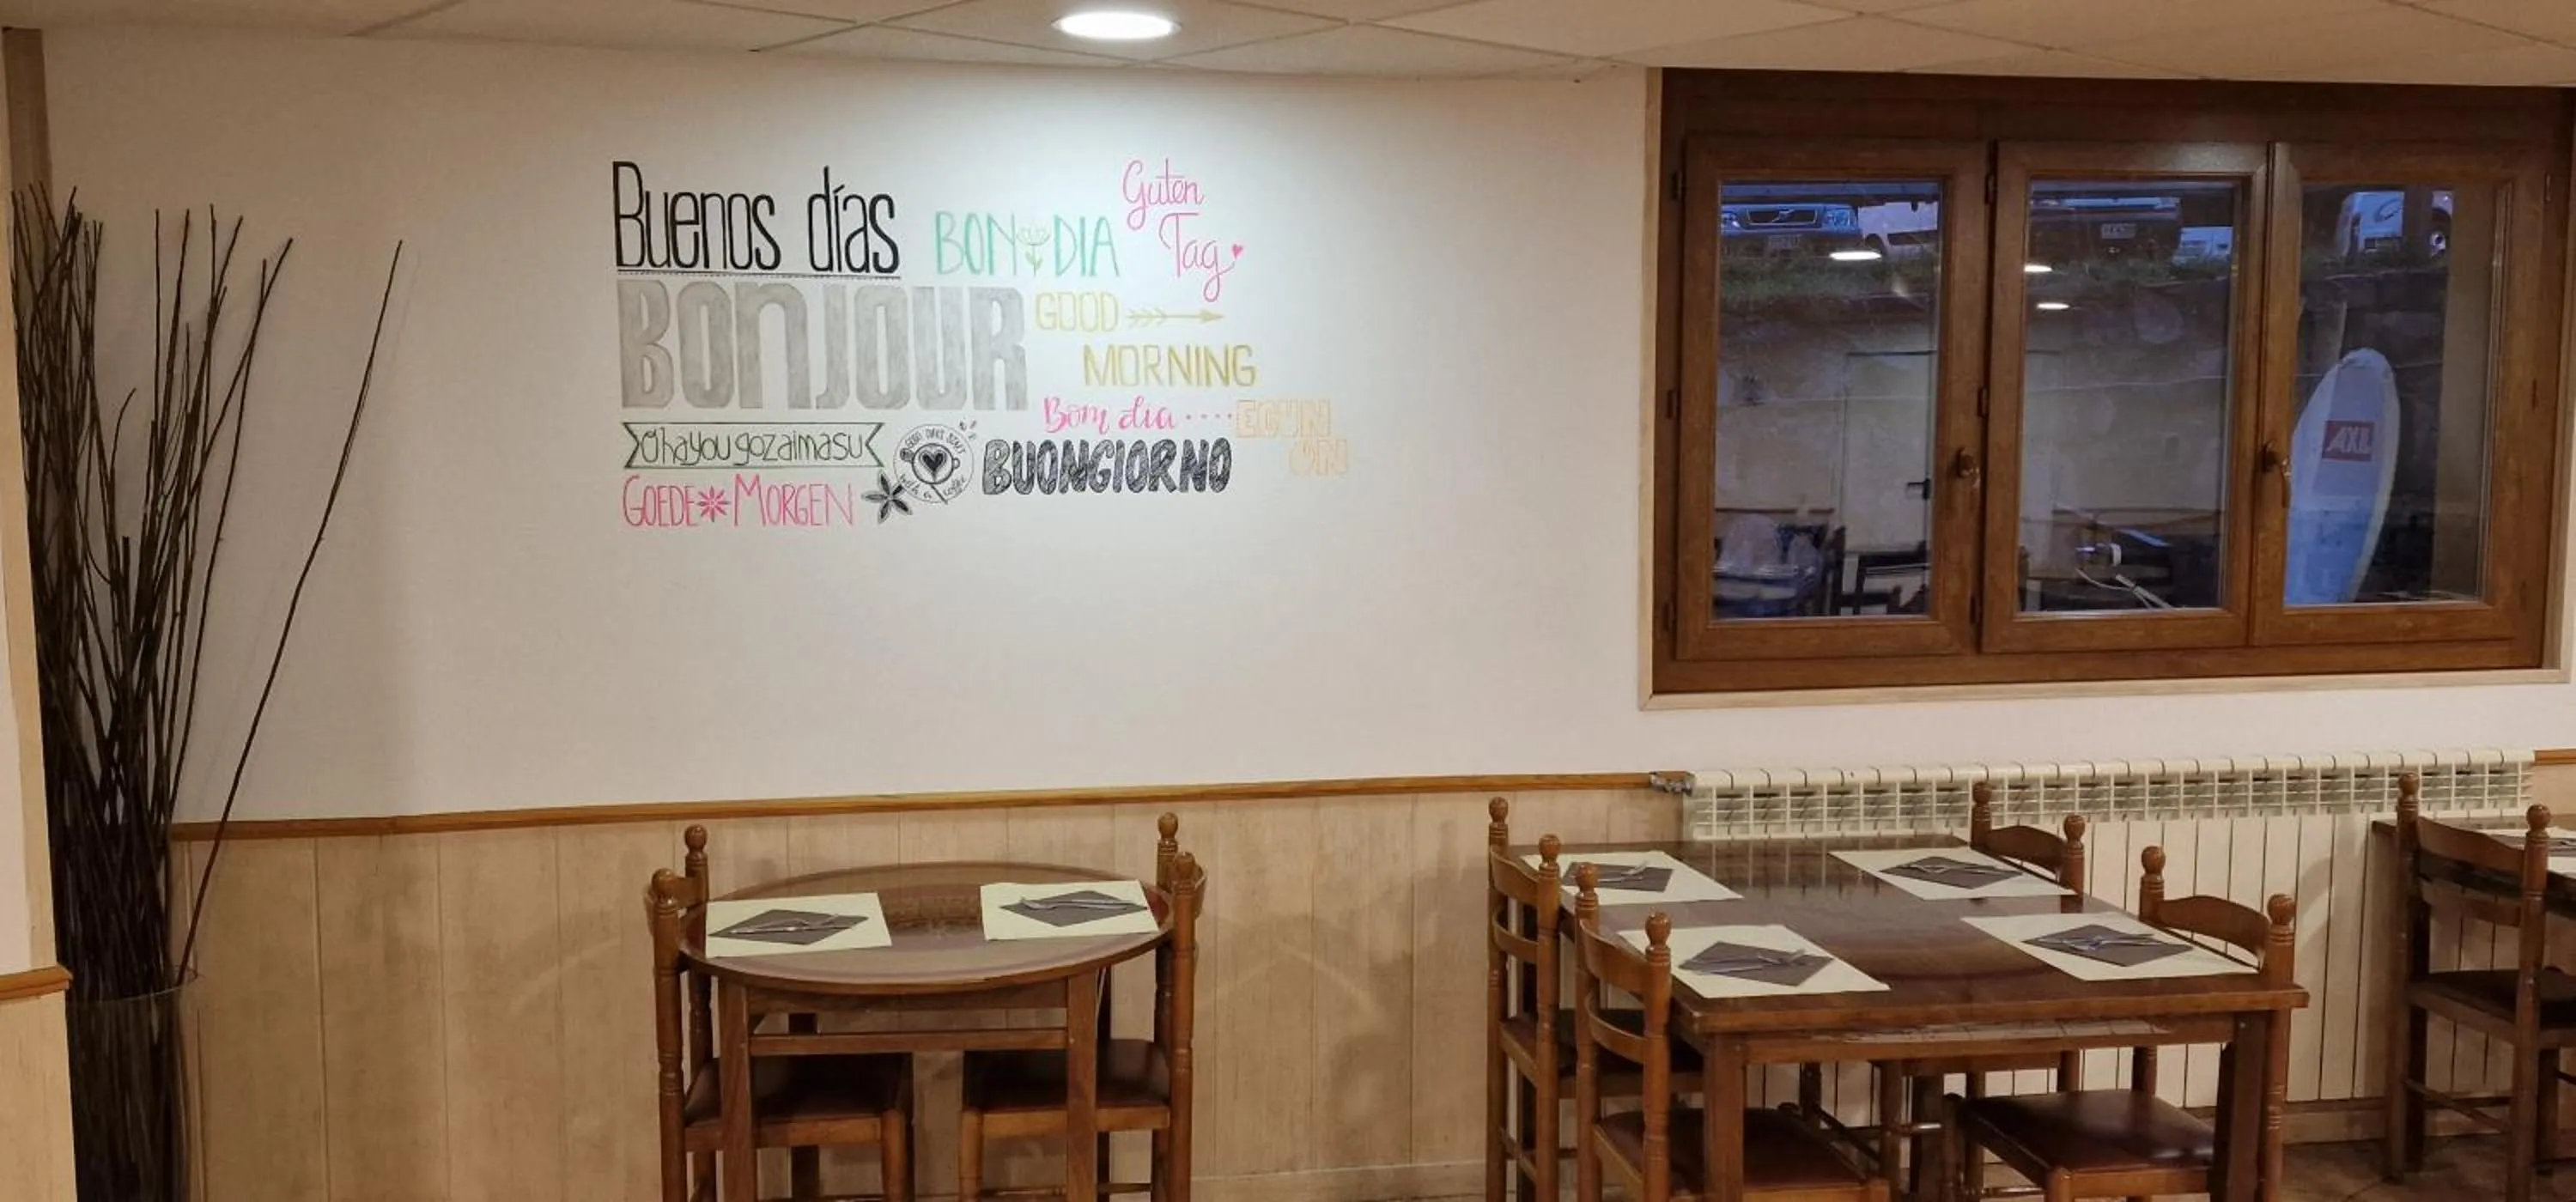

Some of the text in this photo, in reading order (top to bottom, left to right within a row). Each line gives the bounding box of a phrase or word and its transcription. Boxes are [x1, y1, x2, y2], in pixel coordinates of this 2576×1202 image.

[612, 161, 899, 273] Buenos días
[1122, 157, 1205, 231] Guten
[935, 210, 1120, 276] BON DIA
[1159, 212, 1236, 302] Tag
[1035, 292, 1119, 332] GOOD
[1083, 343, 1259, 388] MORNING
[1118, 395, 1176, 429] dia
[982, 437, 1232, 495] BUONGIORNO
